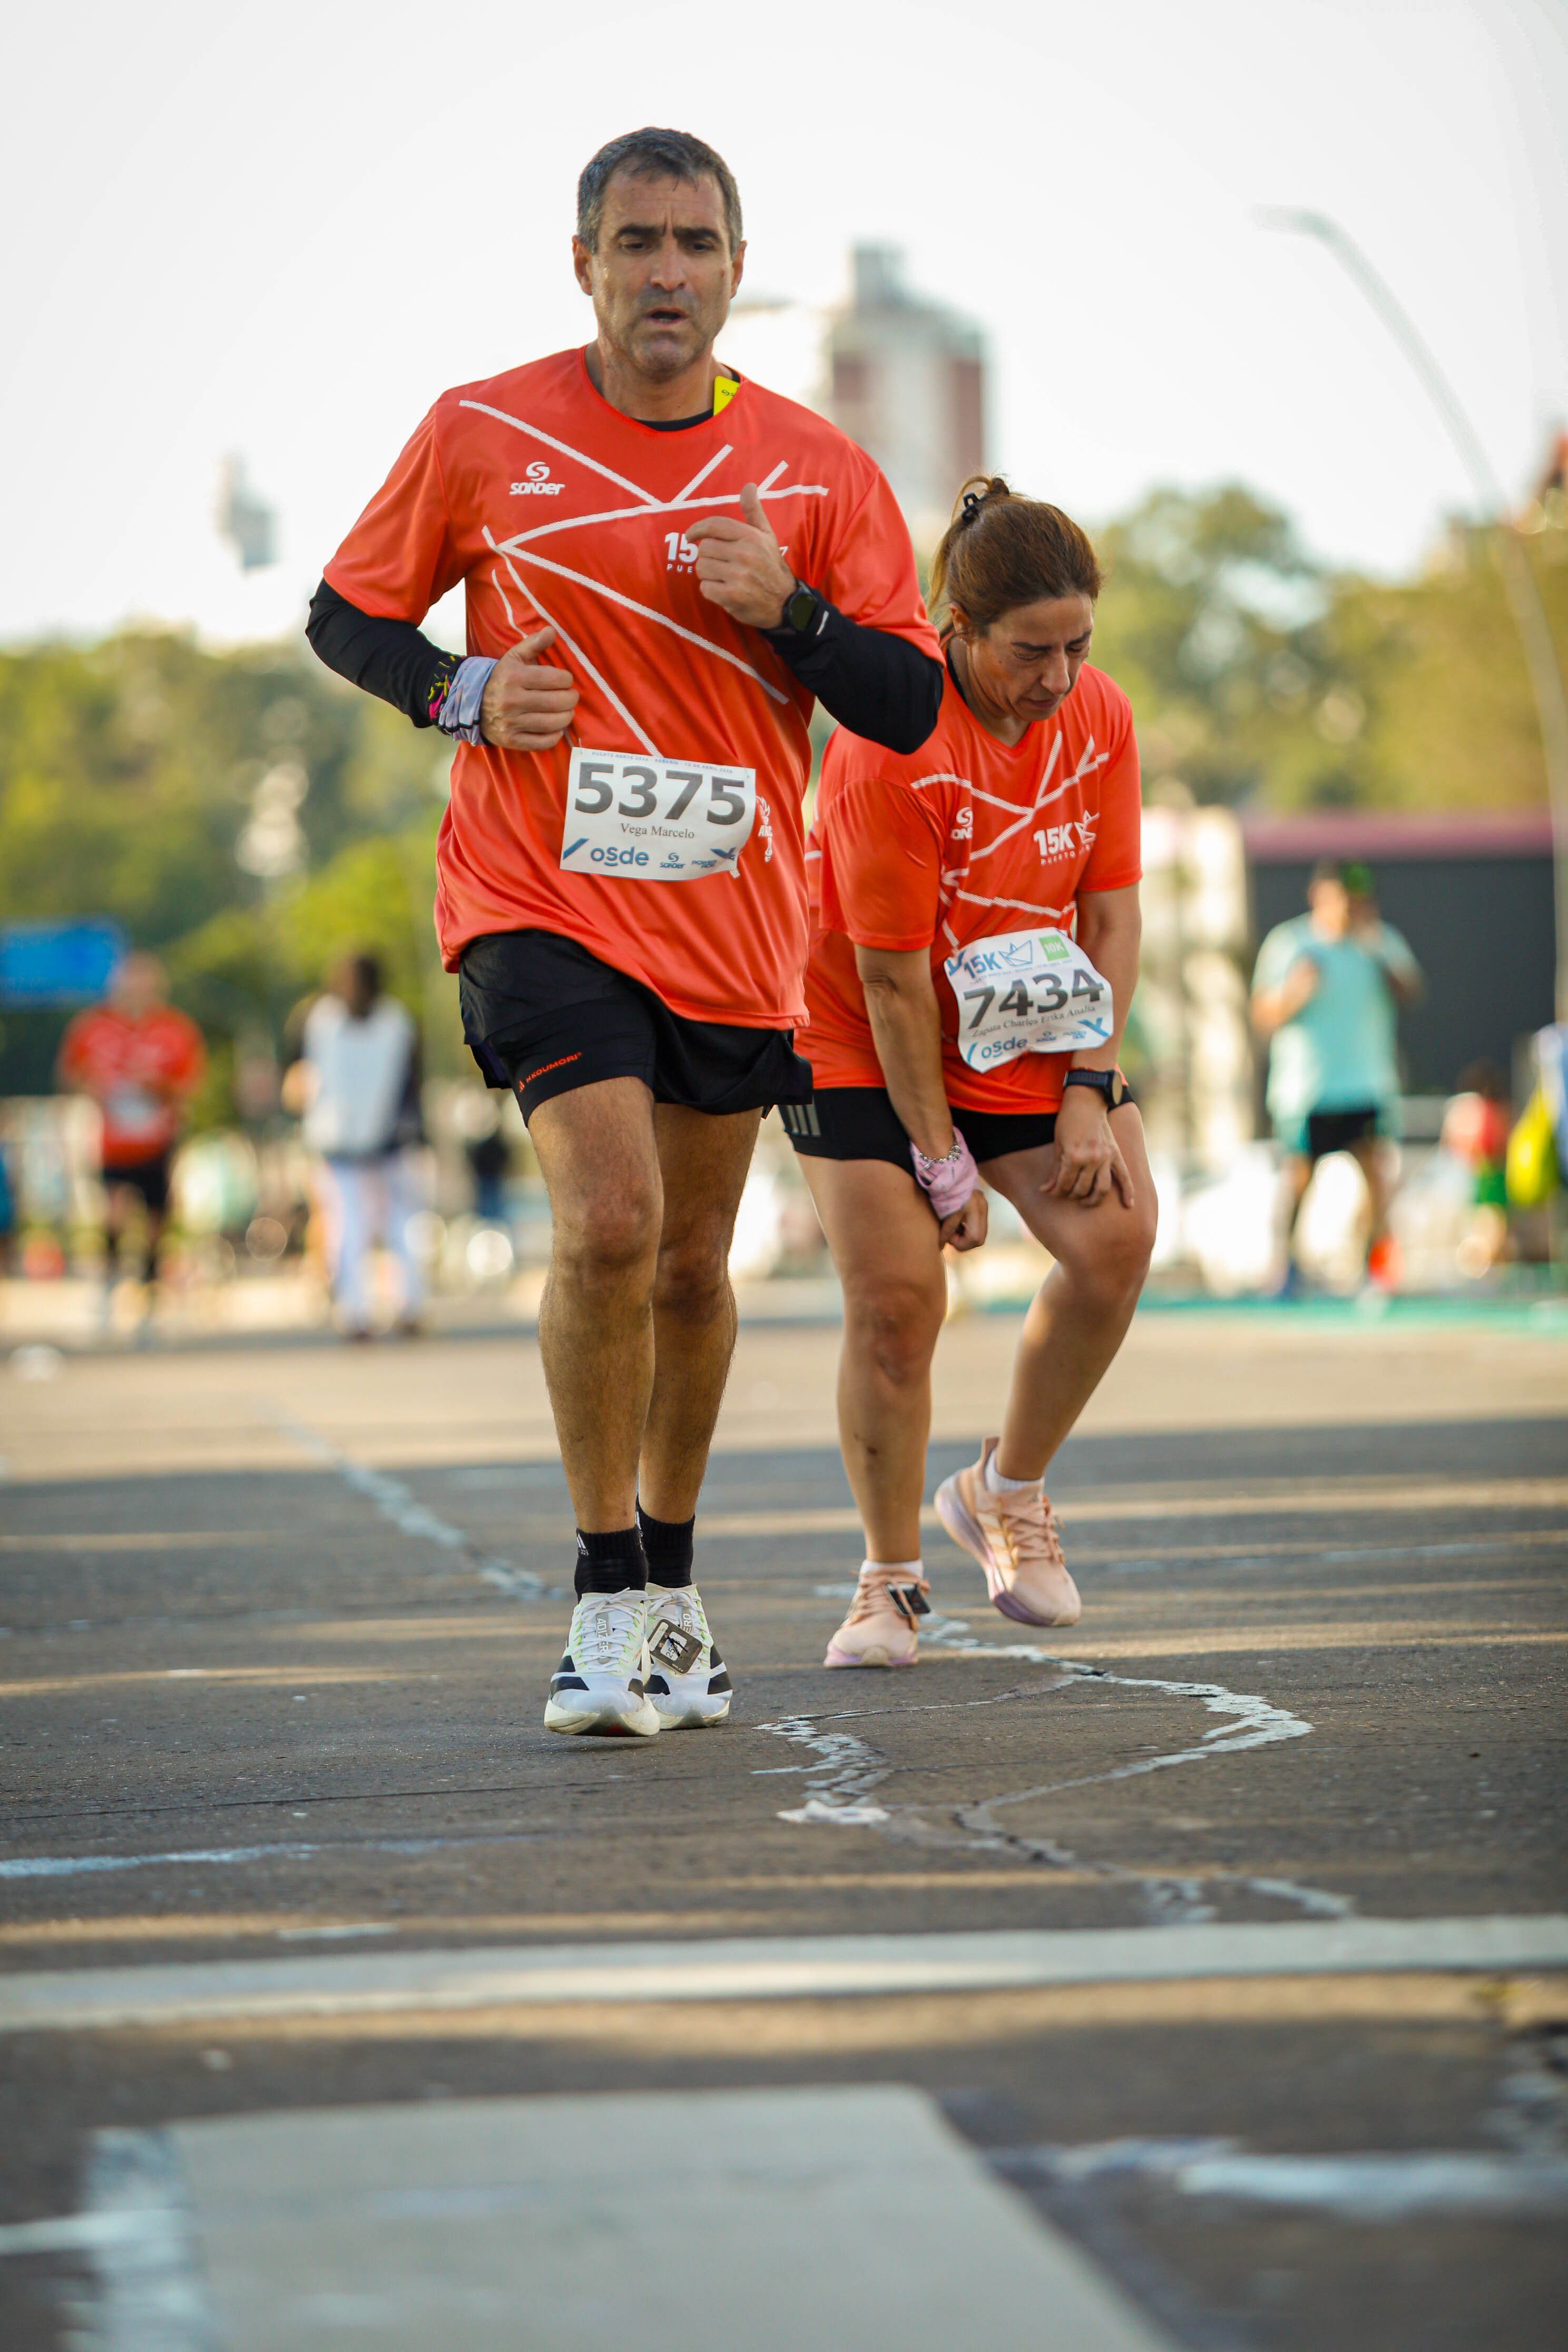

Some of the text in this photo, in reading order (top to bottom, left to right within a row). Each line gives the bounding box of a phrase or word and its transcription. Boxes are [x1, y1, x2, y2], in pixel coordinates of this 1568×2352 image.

[575, 762, 746, 826] 5375
[621, 822, 695, 839] Vega Marcelo
[1033, 822, 1075, 857] 15K
[590, 846, 649, 867] osde
[963, 952, 1002, 979] 15K
[963, 968, 1104, 1030] 7434
[982, 1036, 1027, 1059] osde
